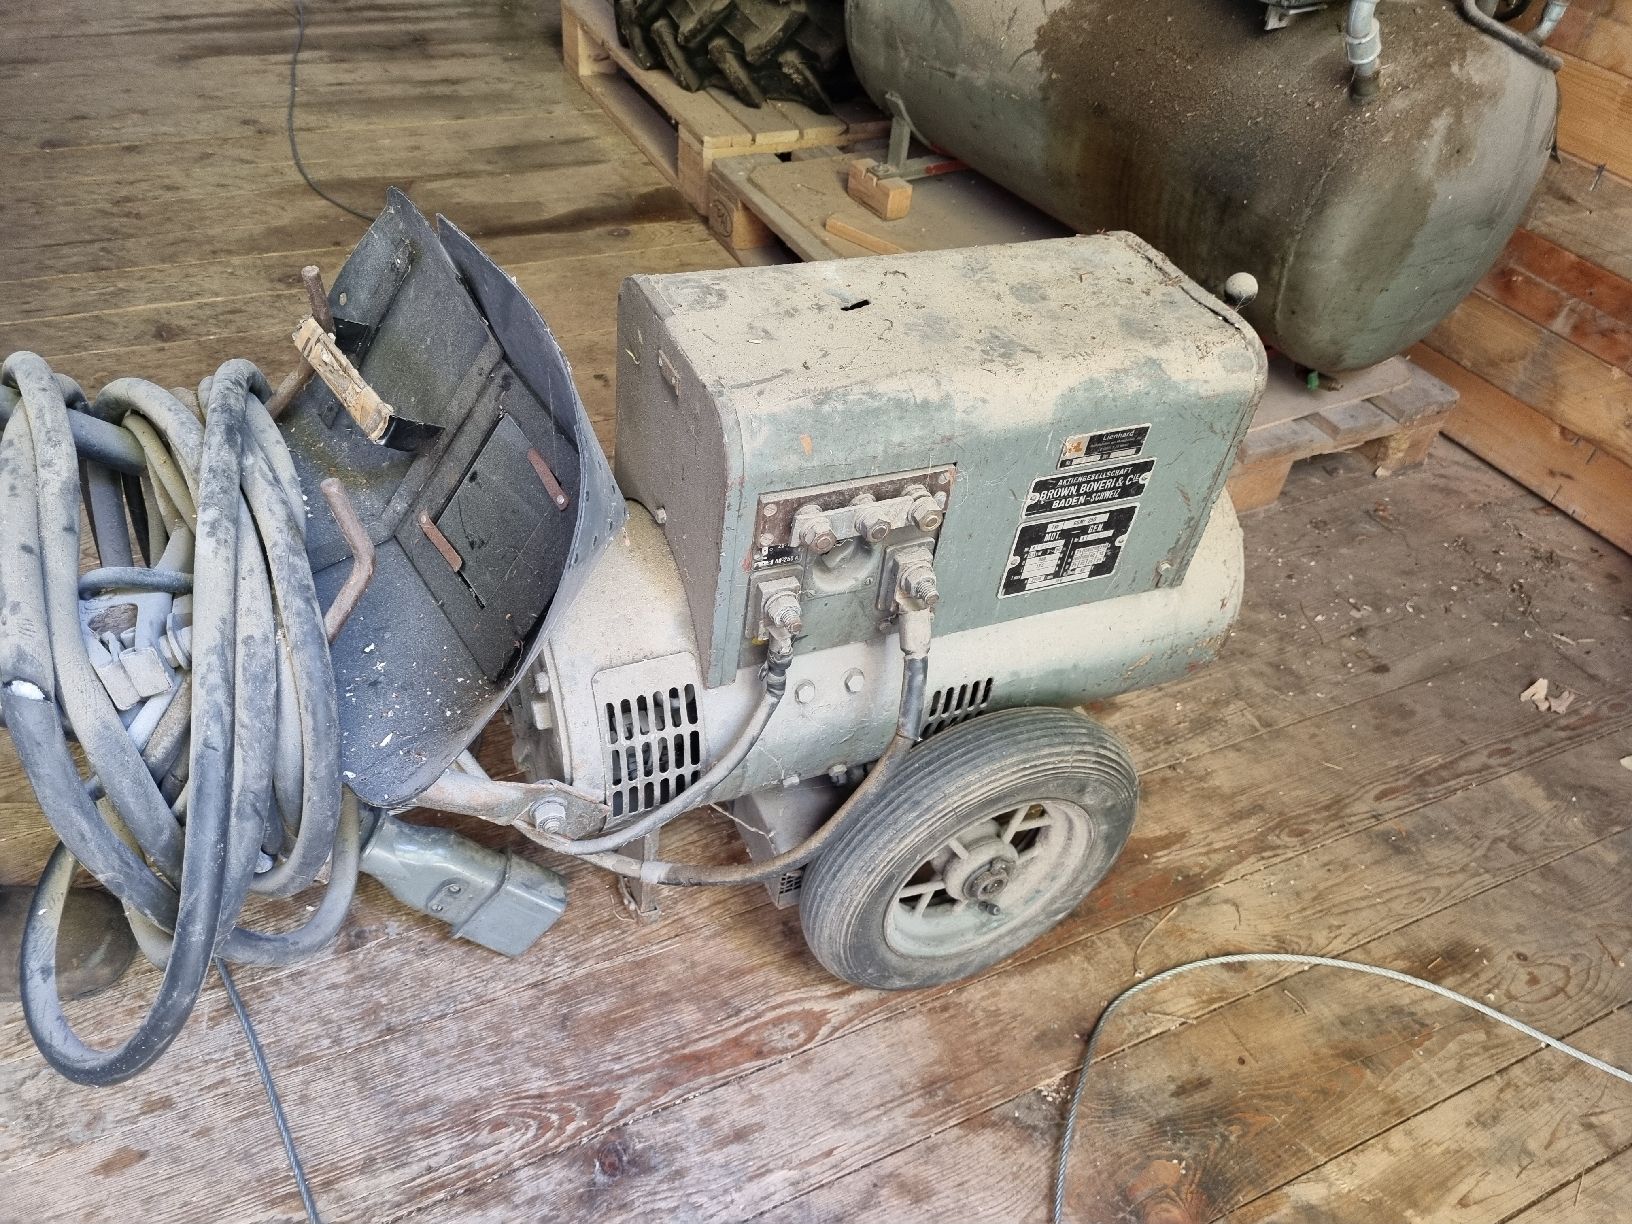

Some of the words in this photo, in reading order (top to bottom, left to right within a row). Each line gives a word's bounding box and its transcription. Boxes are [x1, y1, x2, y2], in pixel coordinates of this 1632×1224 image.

[1103, 430, 1135, 441] Lienhard
[1056, 467, 1133, 487] AKTIENGESELLSCHAFT
[1079, 479, 1117, 494] BOVERI
[1115, 477, 1125, 487] &
[1043, 532, 1060, 542] MOT.
[1088, 523, 1103, 534] GEN.
